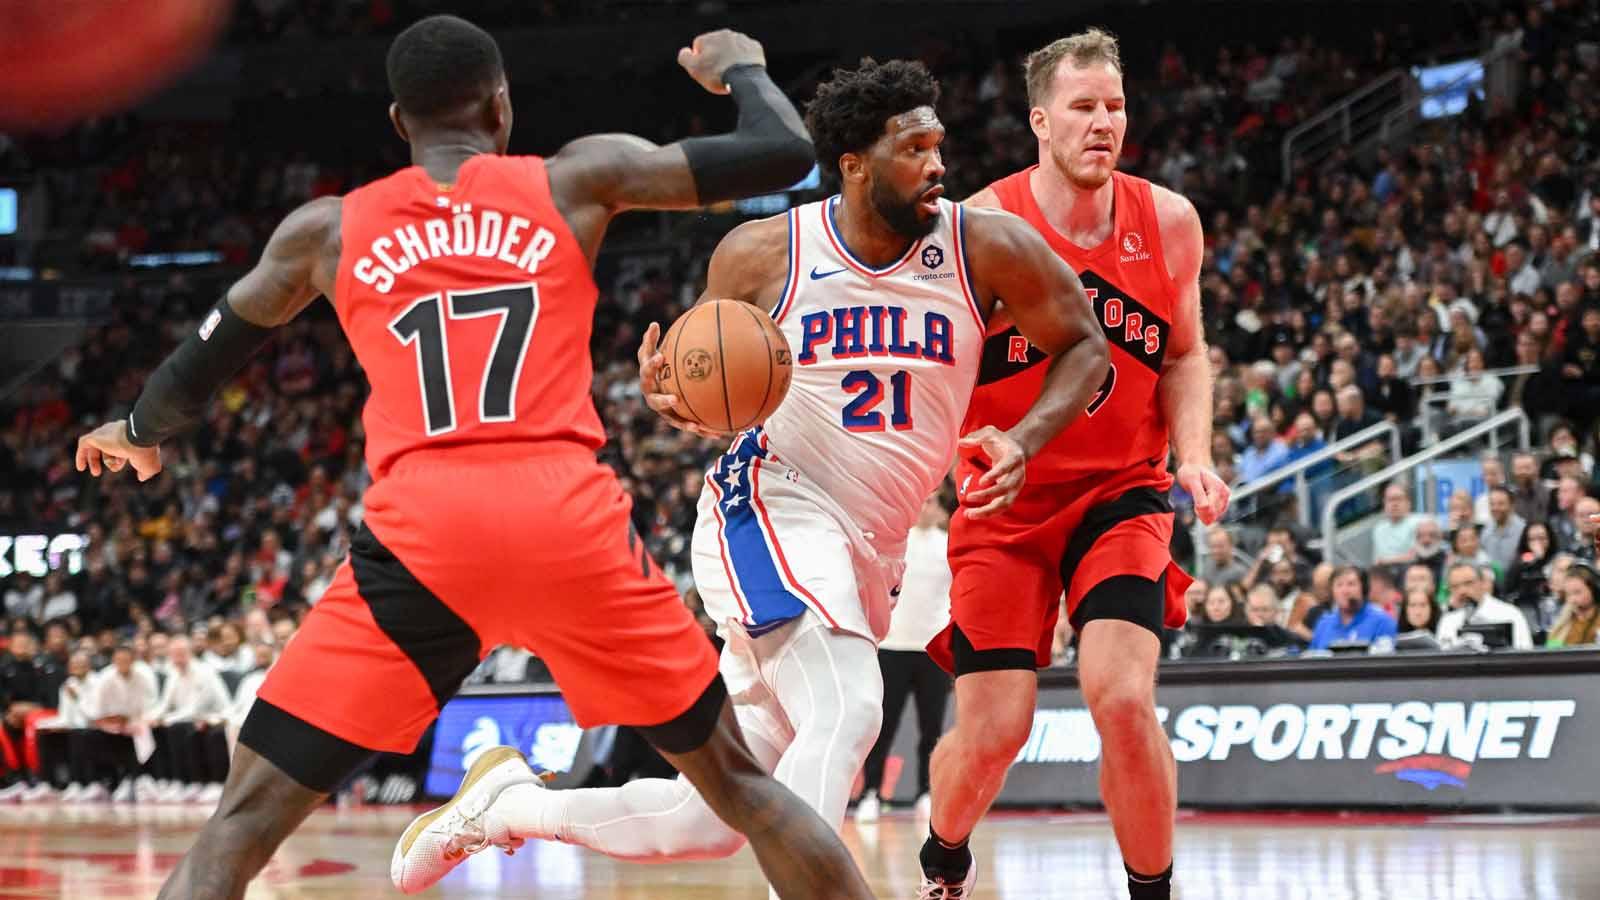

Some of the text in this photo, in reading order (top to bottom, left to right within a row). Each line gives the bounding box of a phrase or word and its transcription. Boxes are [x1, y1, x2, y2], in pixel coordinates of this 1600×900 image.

[353, 203, 557, 294] SCHRÖDER
[912, 272, 956, 282] crypto.com
[798, 306, 956, 366] PHILA
[1008, 288, 1160, 362] RORS
[387, 280, 540, 437] 17
[841, 370, 913, 433] 21
[1171, 700, 1576, 762] SPORTSNET
